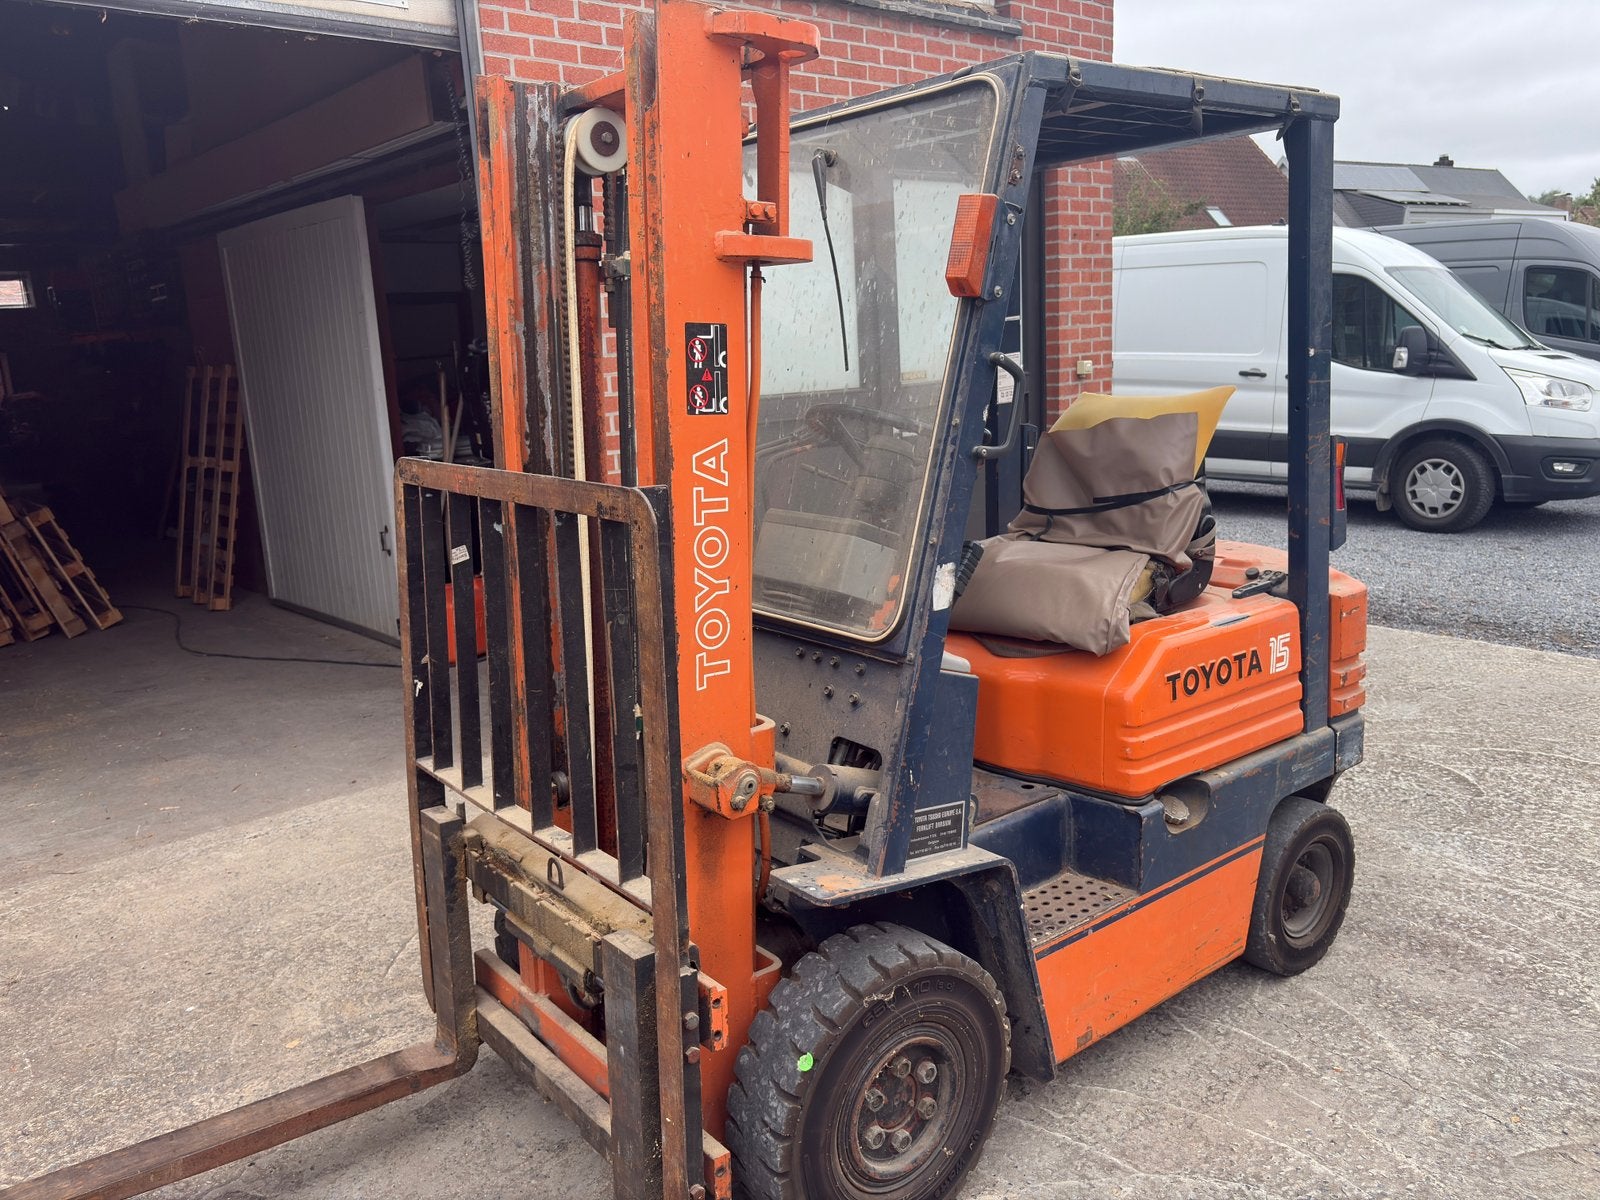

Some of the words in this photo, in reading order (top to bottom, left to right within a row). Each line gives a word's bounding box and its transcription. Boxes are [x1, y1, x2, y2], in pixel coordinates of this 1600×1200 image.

[692, 437, 731, 692] TOYOTA
[1166, 648, 1262, 702] TOYOTA
[1269, 632, 1291, 675] 15
[914, 815, 928, 823] TOYOTA
[942, 809, 955, 818] EUROPE
[916, 822, 934, 832] FORKLIFT
